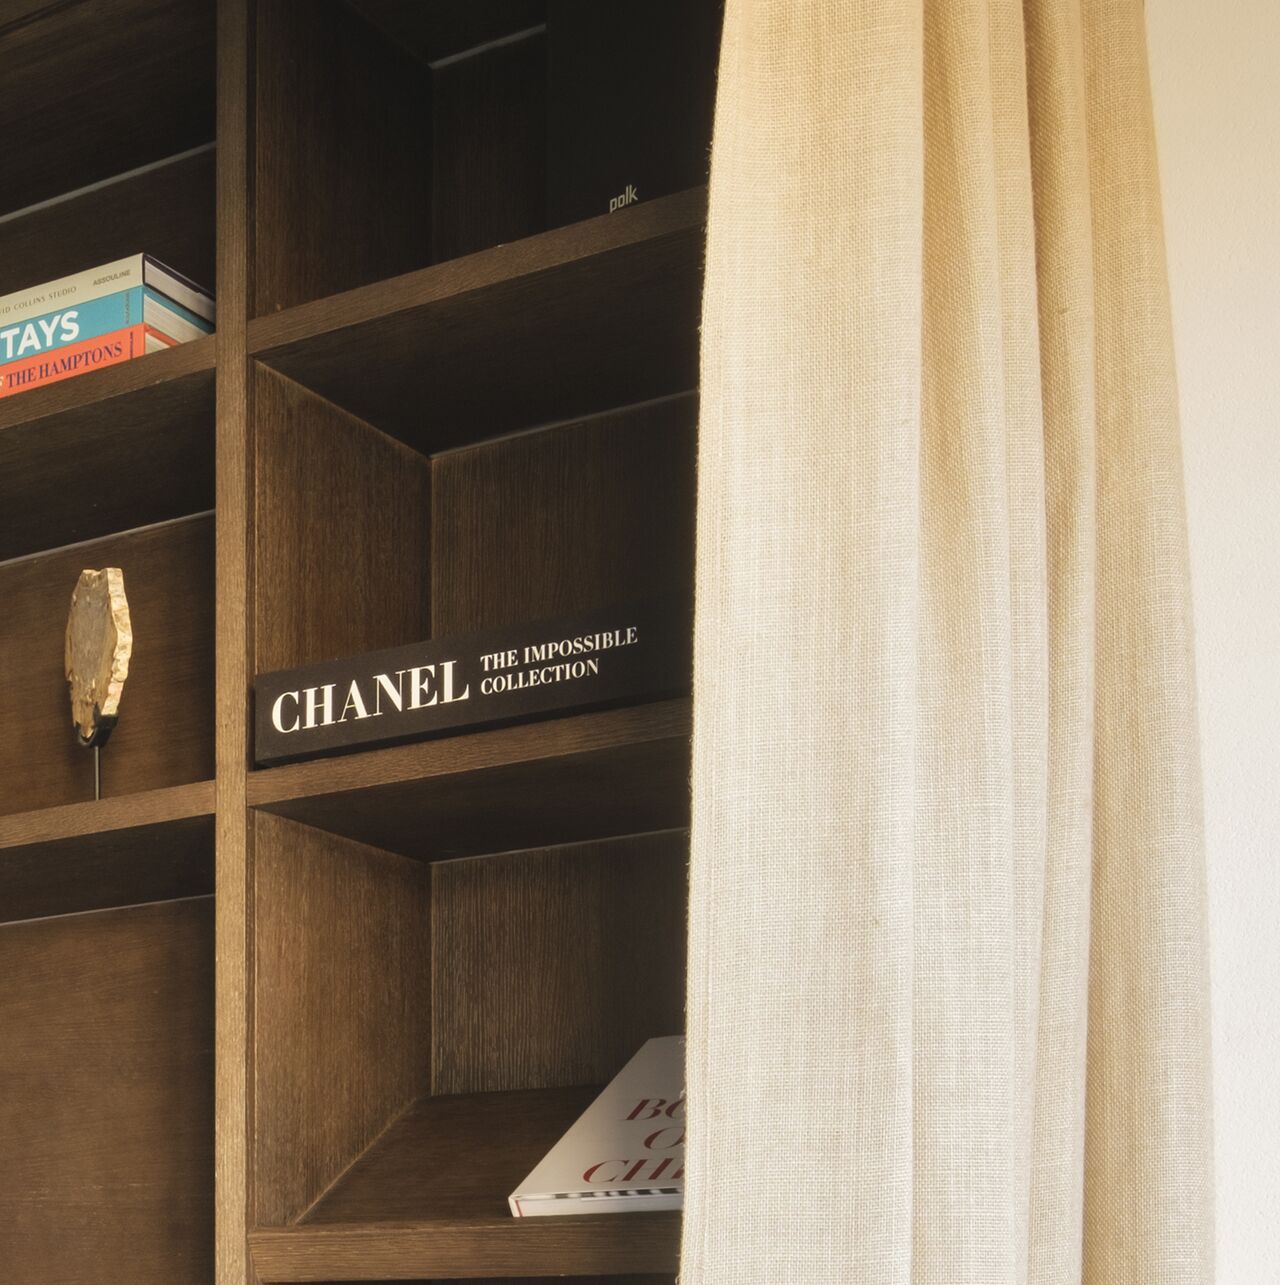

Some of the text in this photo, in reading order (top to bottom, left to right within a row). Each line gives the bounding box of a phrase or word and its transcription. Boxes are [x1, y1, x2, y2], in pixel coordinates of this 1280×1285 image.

[610, 185, 638, 213] polk
[14, 294, 46, 312] COLLINS
[49, 286, 77, 300] STUDIO
[93, 269, 131, 287] ASSOULINE
[6, 367, 37, 388] THE
[40, 342, 123, 380] HAMPTONS
[271, 626, 638, 733] CHANEL THE IMPOSSIBLE
[480, 658, 600, 695] COLLECTION
